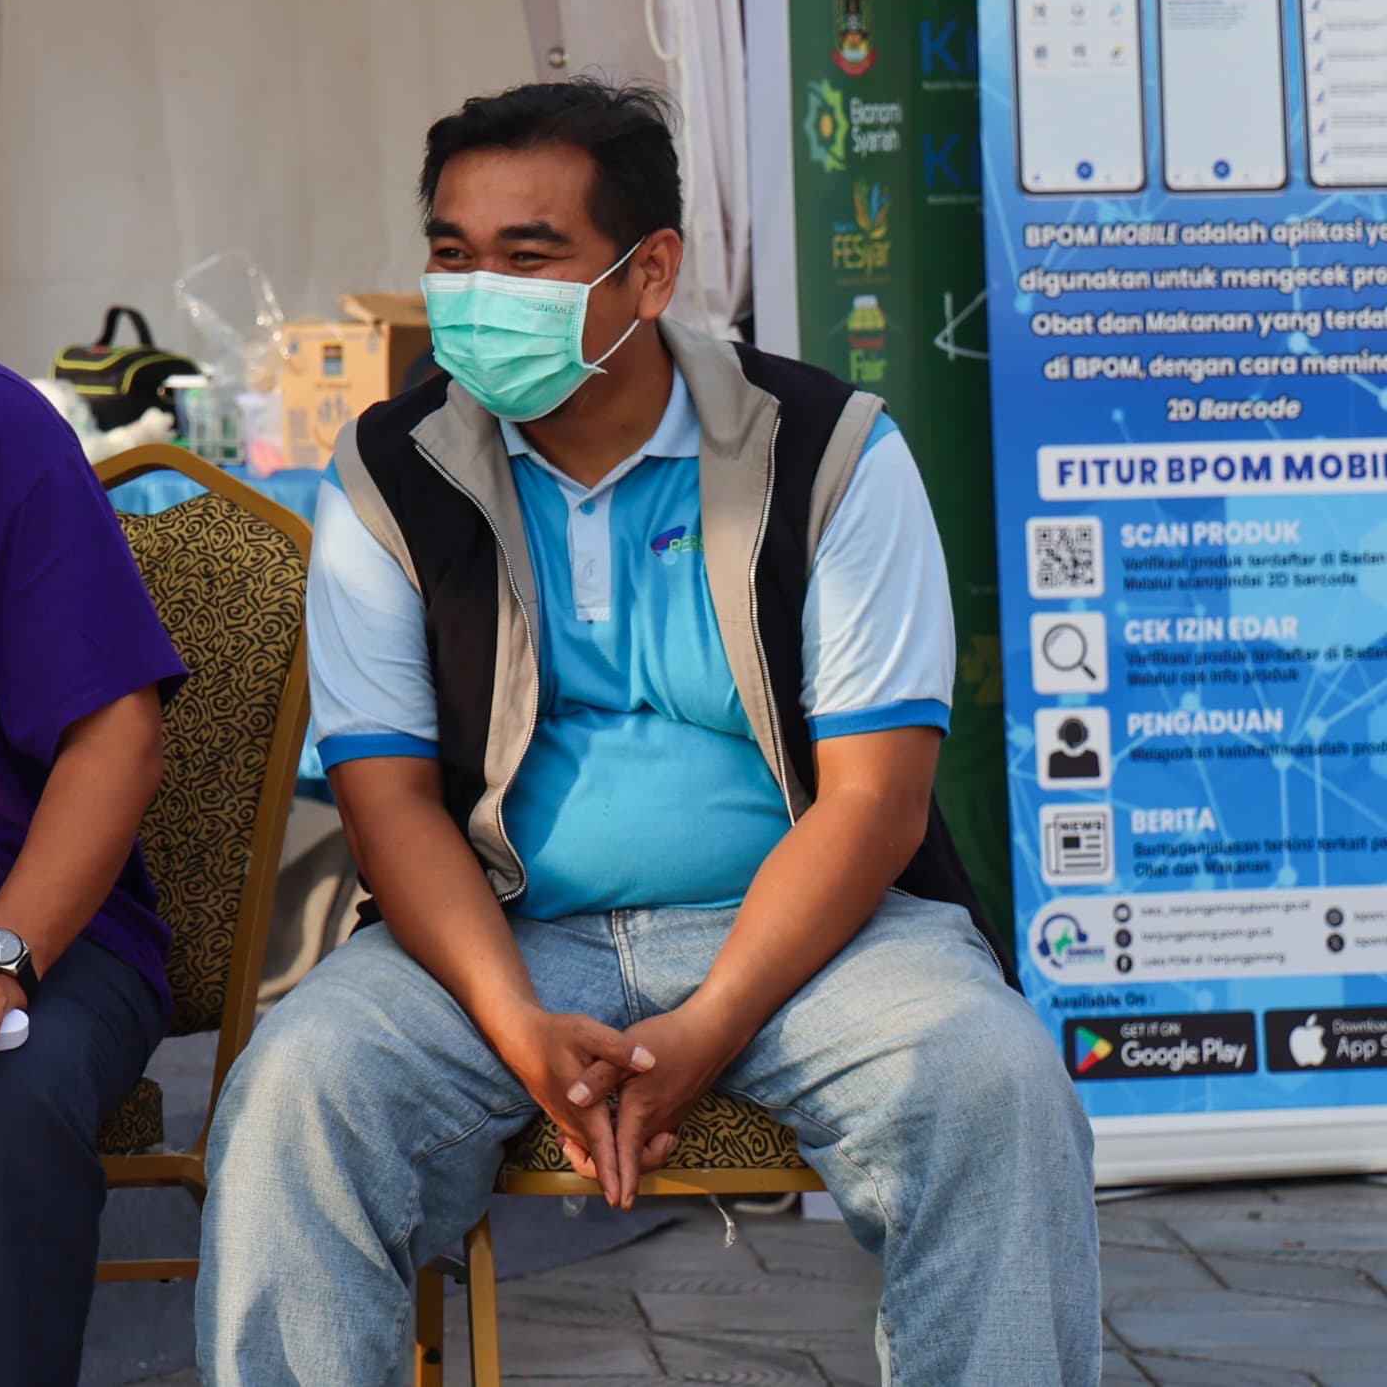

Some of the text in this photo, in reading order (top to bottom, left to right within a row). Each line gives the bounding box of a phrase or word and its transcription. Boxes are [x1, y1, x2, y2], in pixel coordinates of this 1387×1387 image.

[1025, 223, 1100, 248] BPOM
[1101, 222, 1179, 247] MOBILE
[1181, 220, 1266, 246] adalah
[1271, 217, 1363, 250] aplikasi
[1019, 265, 1151, 298] digunakan
[1153, 265, 1218, 290] untuk
[1221, 262, 1350, 295] mengecek
[1031, 312, 1095, 337] Obat
[1097, 310, 1143, 335] dan
[1145, 309, 1254, 334] Makanan
[1257, 311, 1322, 338] yang
[1043, 355, 1071, 380] di
[1148, 355, 1235, 384] dengan
[1238, 355, 1299, 378] cara
[1166, 395, 1302, 422] 2D Barcode
[1057, 458, 1158, 488] FITUR
[1168, 455, 1272, 484] BPOM
[1121, 519, 1301, 549] SCAN PRODUK
[1191, 554, 1244, 570] produk
[1125, 615, 1299, 645] CEK IZIN EDAR
[1127, 708, 1284, 737] PENGADUAN
[1059, 820, 1104, 832] NEWS
[1131, 807, 1216, 834] BERITA
[1051, 992, 1146, 1009] Available On
[1120, 1021, 1181, 1038] GET IT ON
[1120, 1038, 1247, 1072] Google Play
[1336, 1038, 1376, 1063] App
